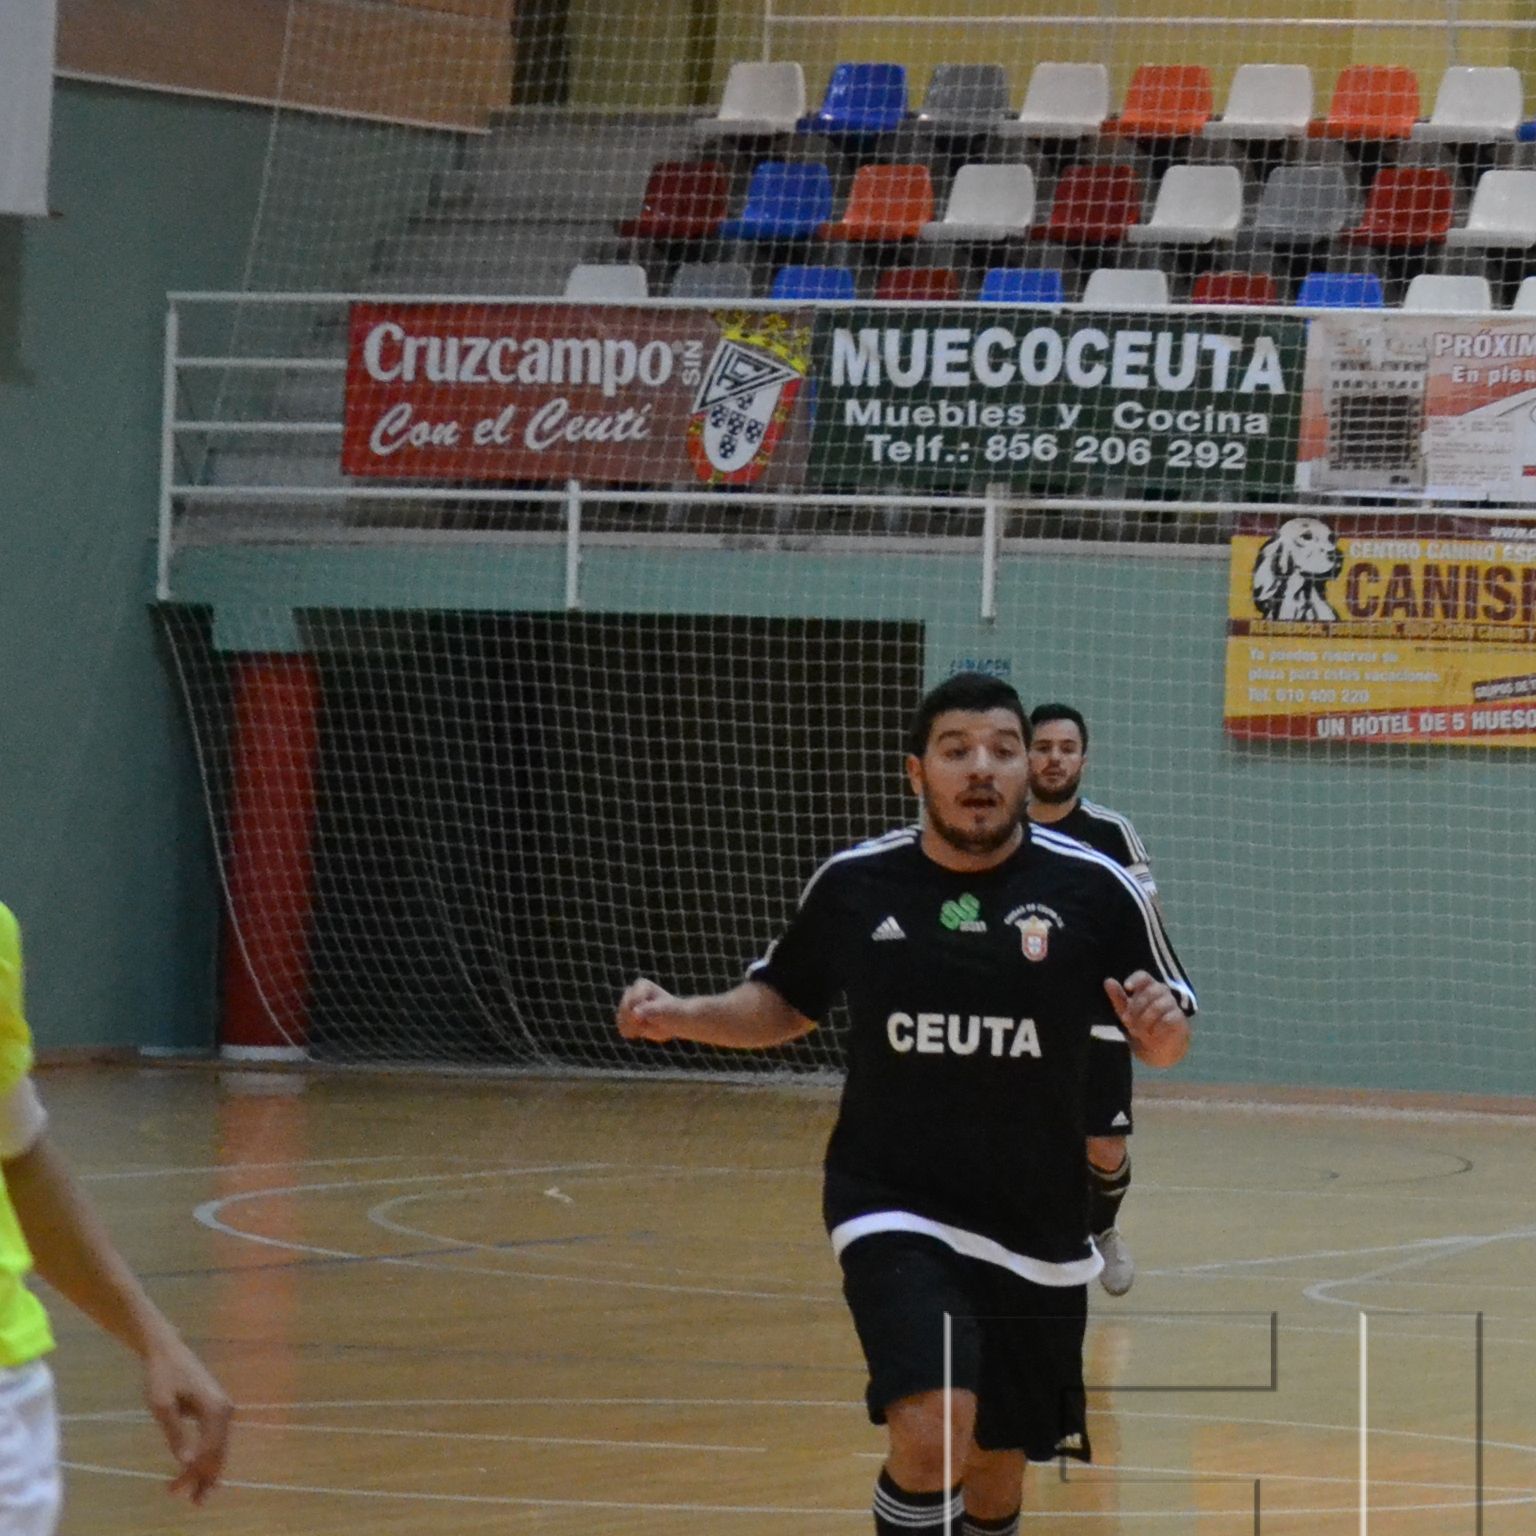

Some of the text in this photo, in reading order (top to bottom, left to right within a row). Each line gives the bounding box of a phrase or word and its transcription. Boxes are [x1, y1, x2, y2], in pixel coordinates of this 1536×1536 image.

[363, 322, 674, 397] Cruzcampo
[681, 340, 703, 385] SIN
[831, 326, 1286, 395] MUECOCEUTA
[1453, 366, 1479, 383] En
[370, 403, 460, 456] Con
[472, 405, 515, 444] el
[843, 400, 1269, 435] Muebles y Cocina
[865, 433, 1247, 471] Telf.: 856 206 292
[1350, 542, 1421, 559] CENTRO
[1317, 717, 1347, 739] UN
[1351, 714, 1413, 737] HOTEL
[1420, 712, 1448, 733] DE
[1452, 711, 1466, 731] 5
[886, 1011, 1042, 1058] CEUTA
